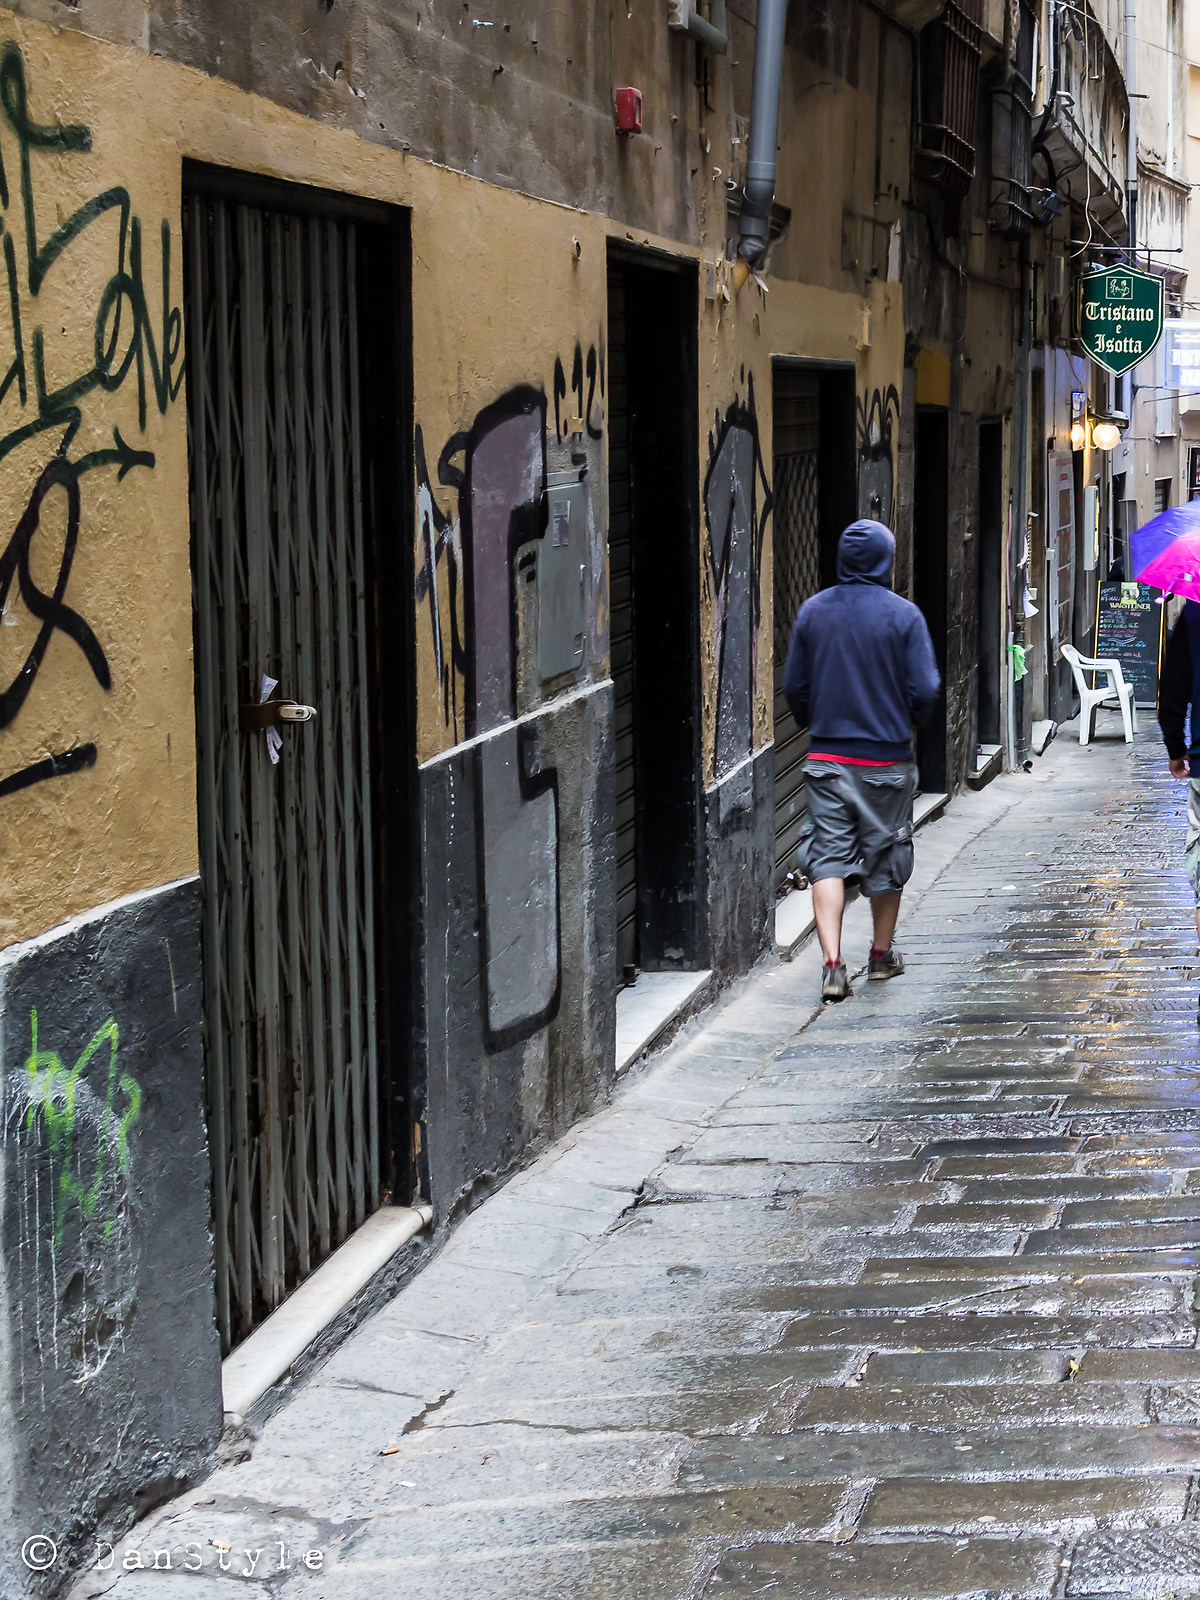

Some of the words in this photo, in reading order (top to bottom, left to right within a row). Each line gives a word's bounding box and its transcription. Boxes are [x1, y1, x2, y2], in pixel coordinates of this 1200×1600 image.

[1085, 301, 1154, 322] Tristano
[1115, 323, 1122, 334] e
[1093, 333, 1143, 354] Isotta
